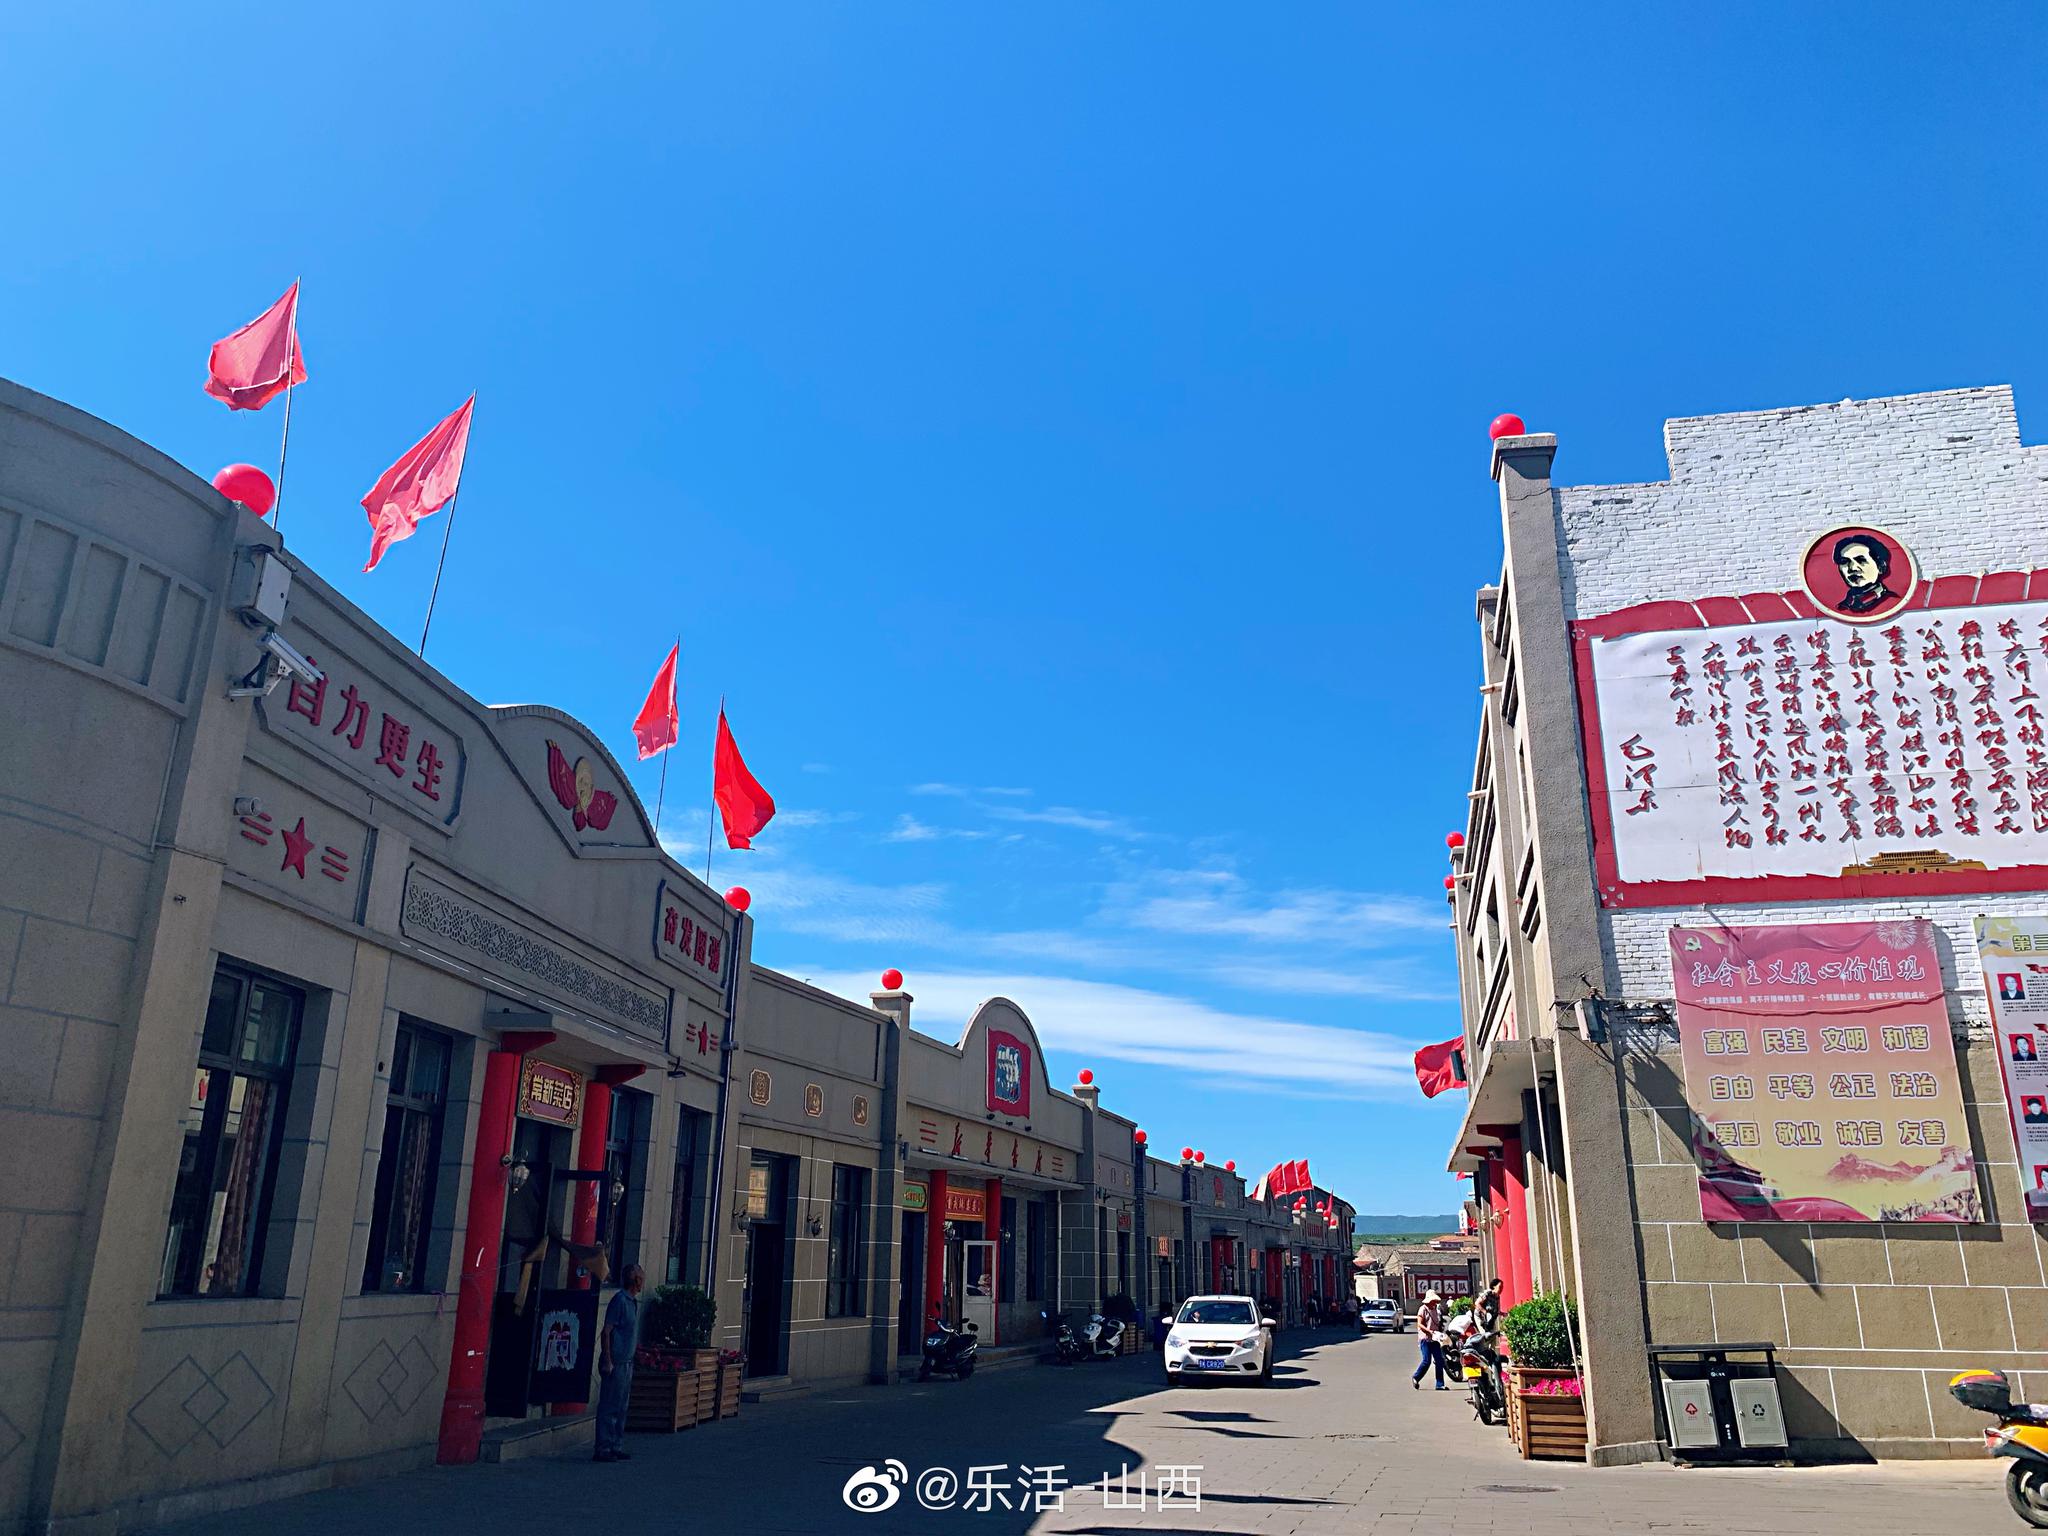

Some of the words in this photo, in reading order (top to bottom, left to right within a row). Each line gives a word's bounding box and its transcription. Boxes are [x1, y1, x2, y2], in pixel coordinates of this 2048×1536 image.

[286, 655, 447, 802] 自力更生
[1619, 733, 1659, 817] 毛泽东
[662, 904, 723, 976] 奋发图强
[1702, 1028, 1750, 1056] 富强
[1762, 1027, 1809, 1054] 民主
[1821, 1026, 1868, 1053] 文明
[1882, 1025, 1931, 1052] 和谐
[1709, 1074, 1754, 1101] 自由
[1768, 1074, 1815, 1100] 平等
[1829, 1073, 1877, 1100] 公正
[1890, 1073, 1938, 1098] 法治
[1714, 1120, 1761, 1147] 爱国
[1775, 1120, 1822, 1146] 敬业
[1836, 1120, 1884, 1147] 诚信
[1898, 1119, 1947, 1147] 友善
